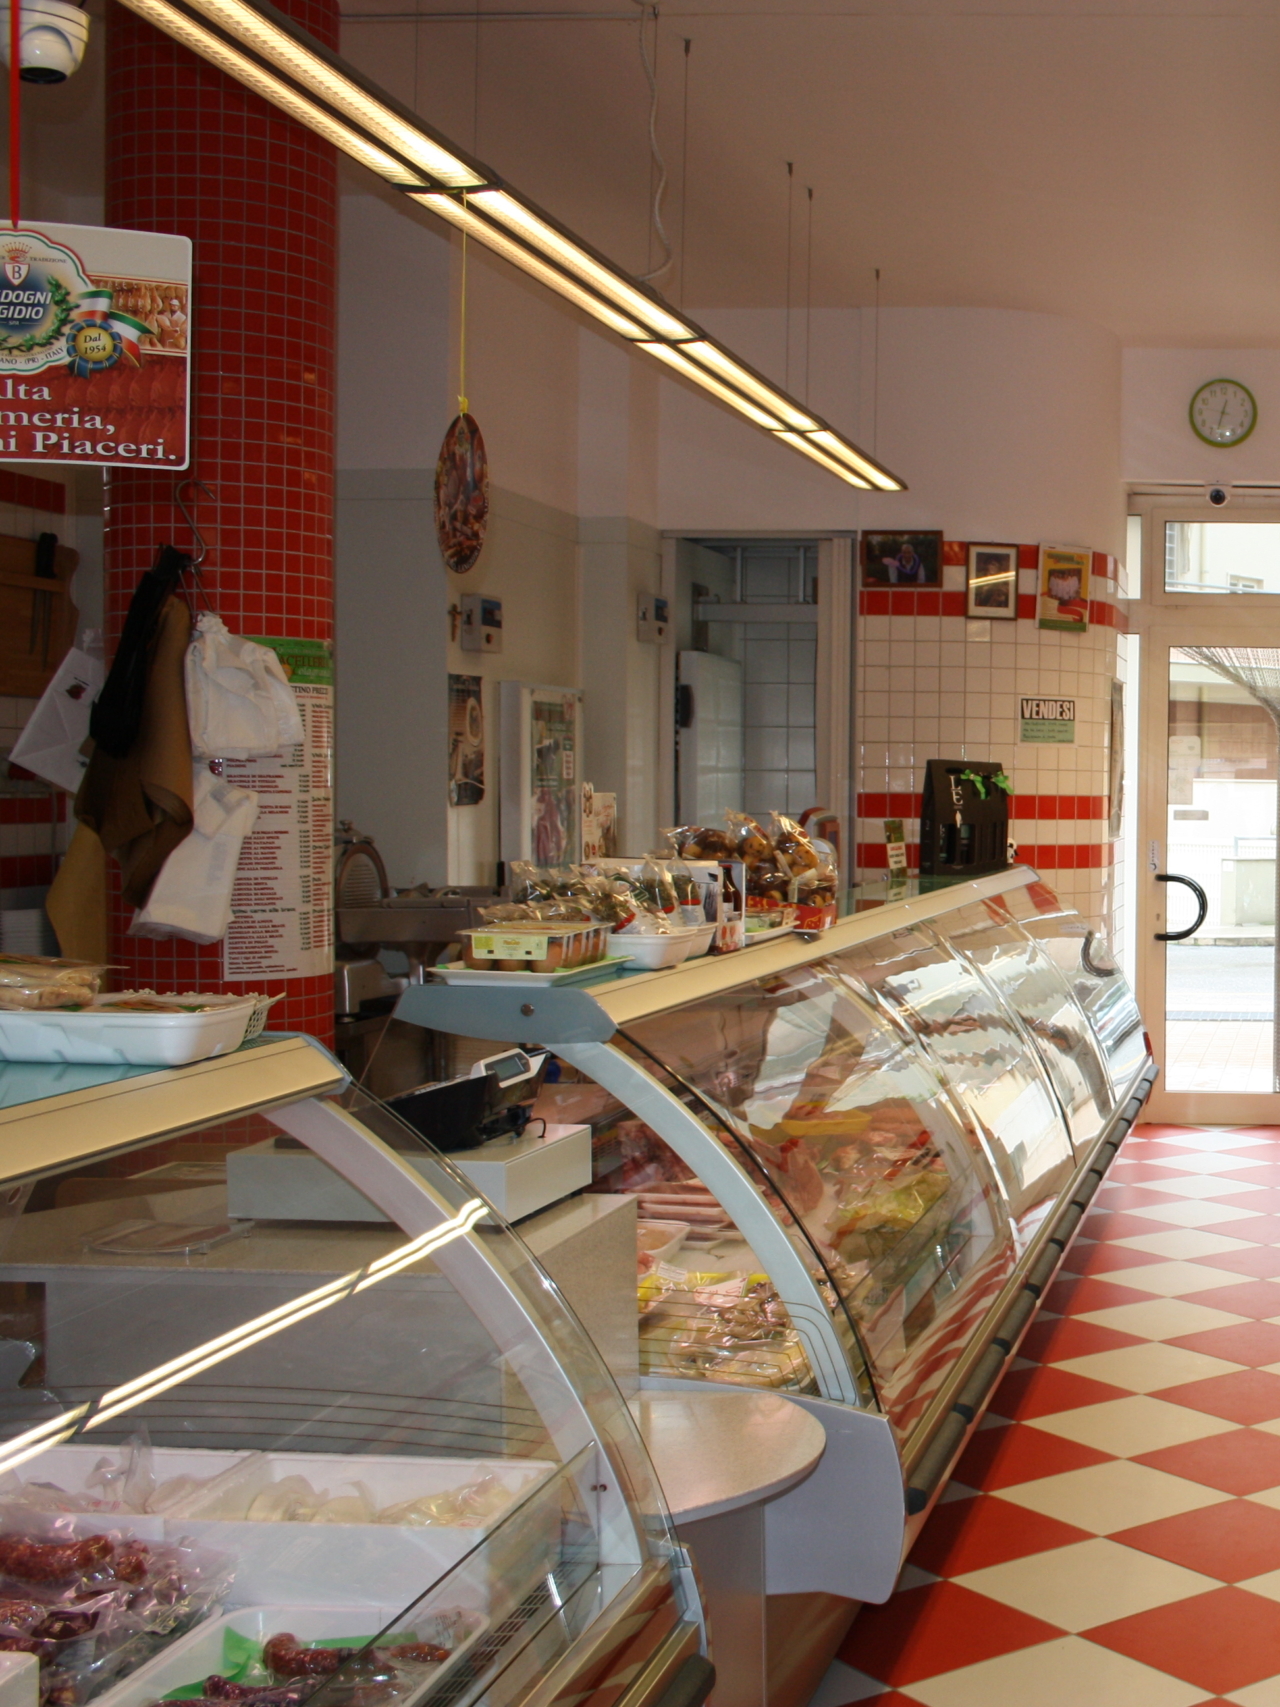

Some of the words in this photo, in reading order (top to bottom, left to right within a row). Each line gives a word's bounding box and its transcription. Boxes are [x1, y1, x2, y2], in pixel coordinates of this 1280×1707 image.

[12, 265, 22, 280] B
[0, 290, 52, 305] DOGNI
[0, 305, 44, 319] GIDIO
[84, 333, 102, 344] Dal
[24, 357, 40, 366] (PR)
[45, 346, 65, 360] ITALY
[84, 344, 107, 355] 1954
[0, 407, 115, 435] meria,
[32, 431, 177, 460] Piaceri.
[280, 654, 329, 668] ACELLERI
[1022, 700, 1074, 720] VENDESI
